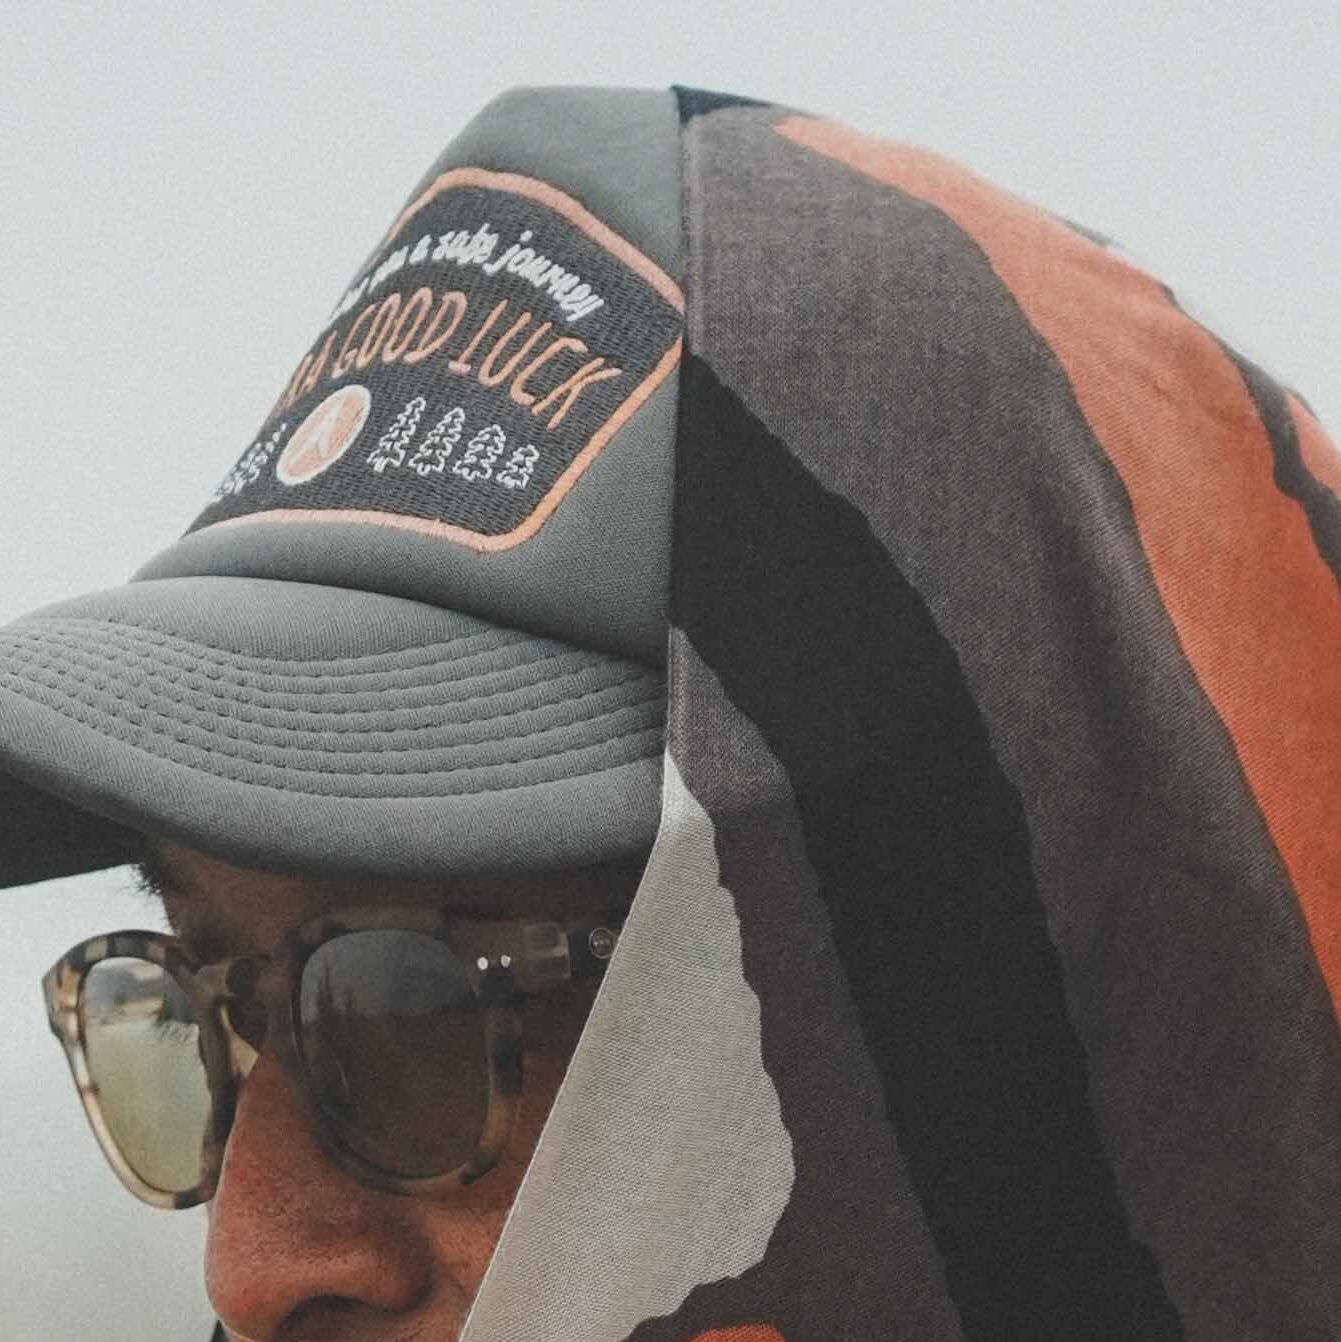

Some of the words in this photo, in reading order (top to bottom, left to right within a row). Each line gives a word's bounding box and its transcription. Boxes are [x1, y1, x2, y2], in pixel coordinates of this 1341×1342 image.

[483, 230, 605, 322] journey
[332, 287, 466, 379] GOOD
[449, 299, 623, 430] LUCK
